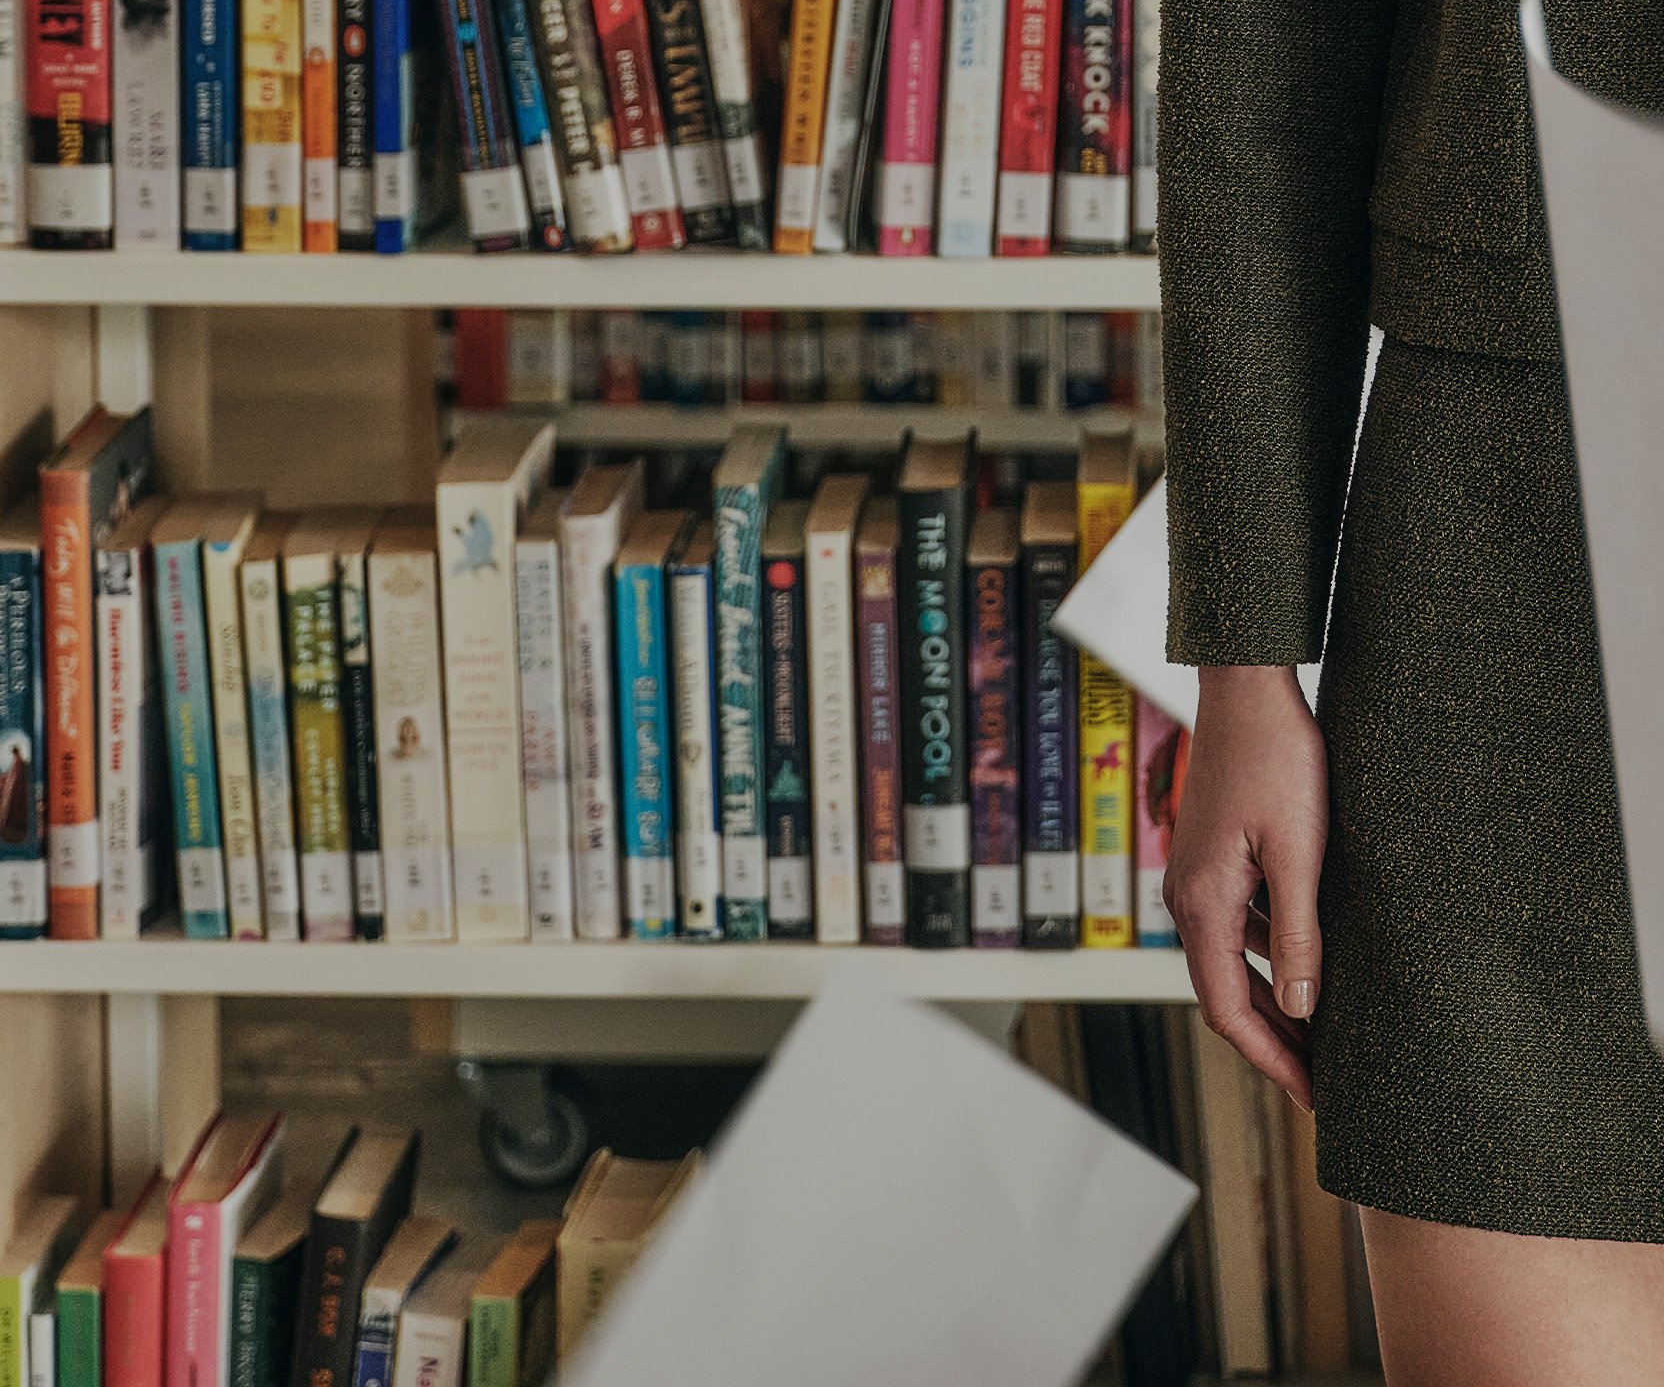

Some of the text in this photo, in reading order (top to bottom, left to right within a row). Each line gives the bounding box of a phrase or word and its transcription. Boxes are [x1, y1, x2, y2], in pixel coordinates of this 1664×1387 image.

[1021, 13, 1046, 46] RED
[614, 49, 639, 104] DEREK
[1019, 50, 1044, 94] COAT
[1080, 25, 1113, 135] KNOCK
[56, 92, 84, 166] BURN
[344, 63, 365, 169] NORTHER
[557, 86, 588, 155] PETER
[9, 588, 31, 695] PERILOUS
[294, 604, 315, 694] PALACE
[316, 589, 338, 713] THE PAPER
[869, 621, 890, 692] MIRROR
[916, 511, 953, 783] THE MOON POOL
[870, 696, 891, 744] LAKE
[1038, 688, 1063, 725] YOU
[722, 703, 758, 836] ANNE TYL
[1038, 731, 1062, 778] LOVE
